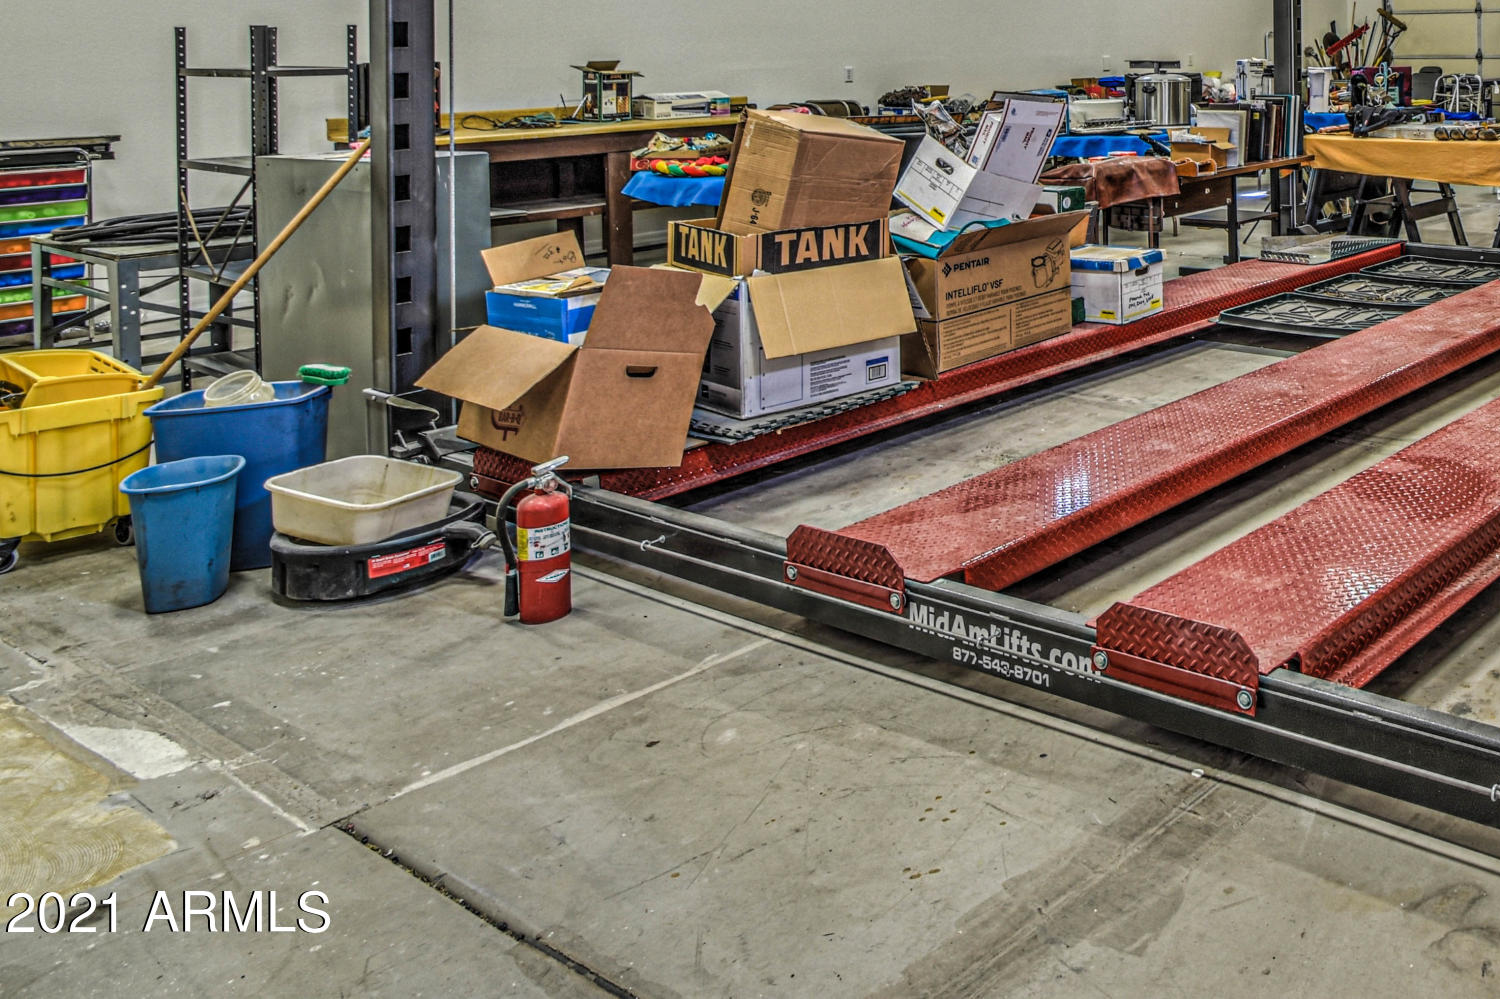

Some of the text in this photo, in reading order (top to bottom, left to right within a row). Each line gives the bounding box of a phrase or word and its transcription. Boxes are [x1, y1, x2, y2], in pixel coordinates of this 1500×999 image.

[679, 225, 727, 268] TANK
[774, 224, 870, 267] TANK
[953, 257, 990, 272] PENTAIR
[989, 279, 1004, 290] VSF
[952, 646, 1051, 688] 877-543-8701
